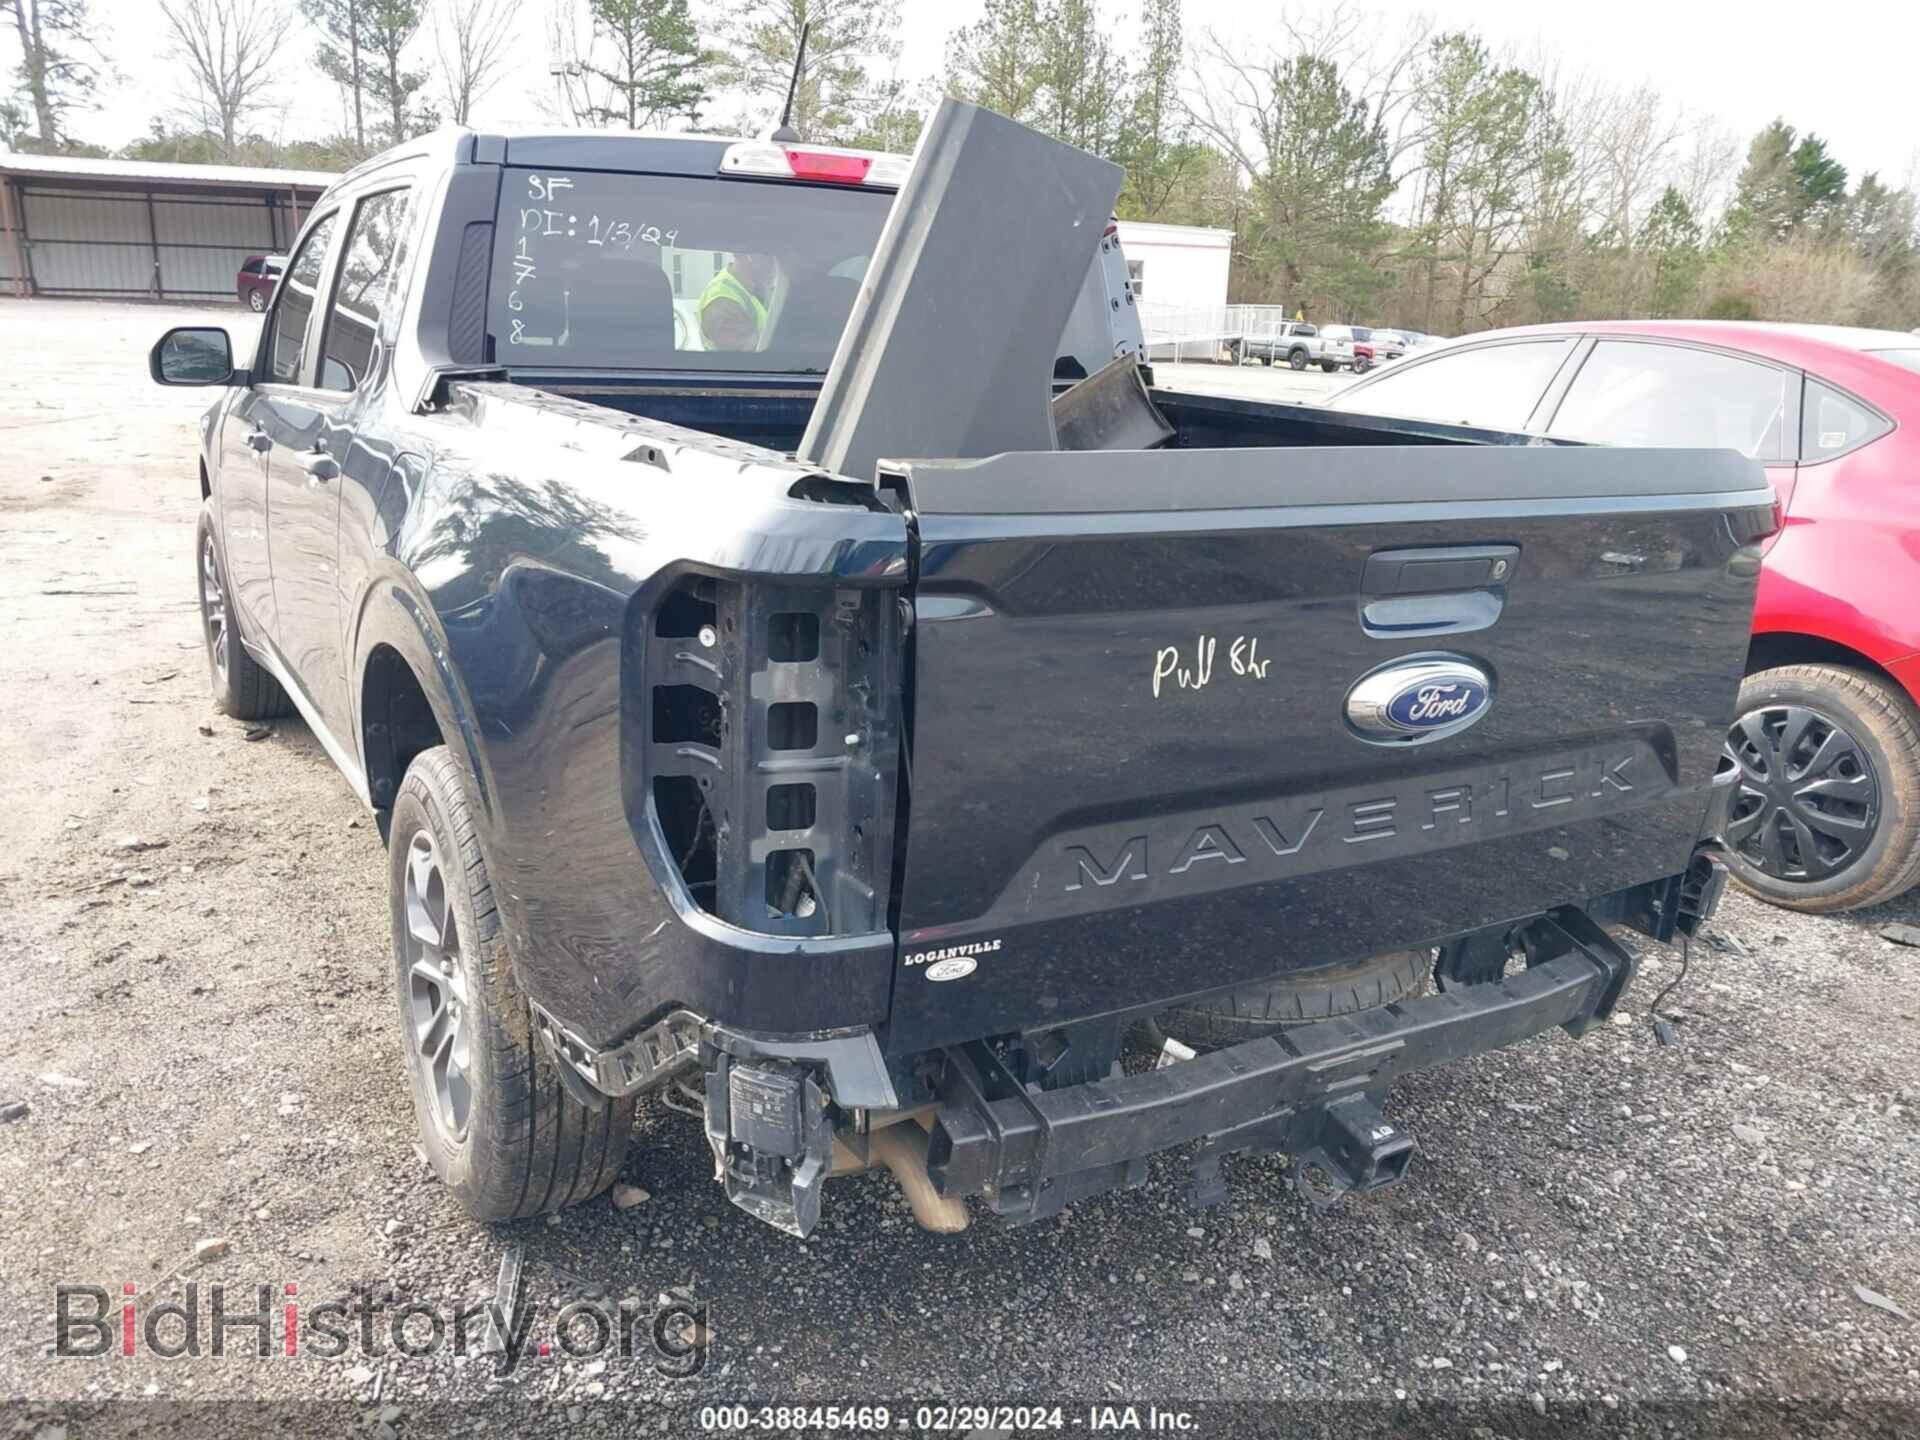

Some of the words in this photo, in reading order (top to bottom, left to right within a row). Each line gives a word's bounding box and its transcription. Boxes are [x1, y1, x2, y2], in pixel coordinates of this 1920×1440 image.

[528, 174, 574, 201] SF
[1409, 684, 1470, 721] Ford
[1064, 756, 1633, 891] MAVERICK
[904, 939, 1002, 966] LOGANVILLE
